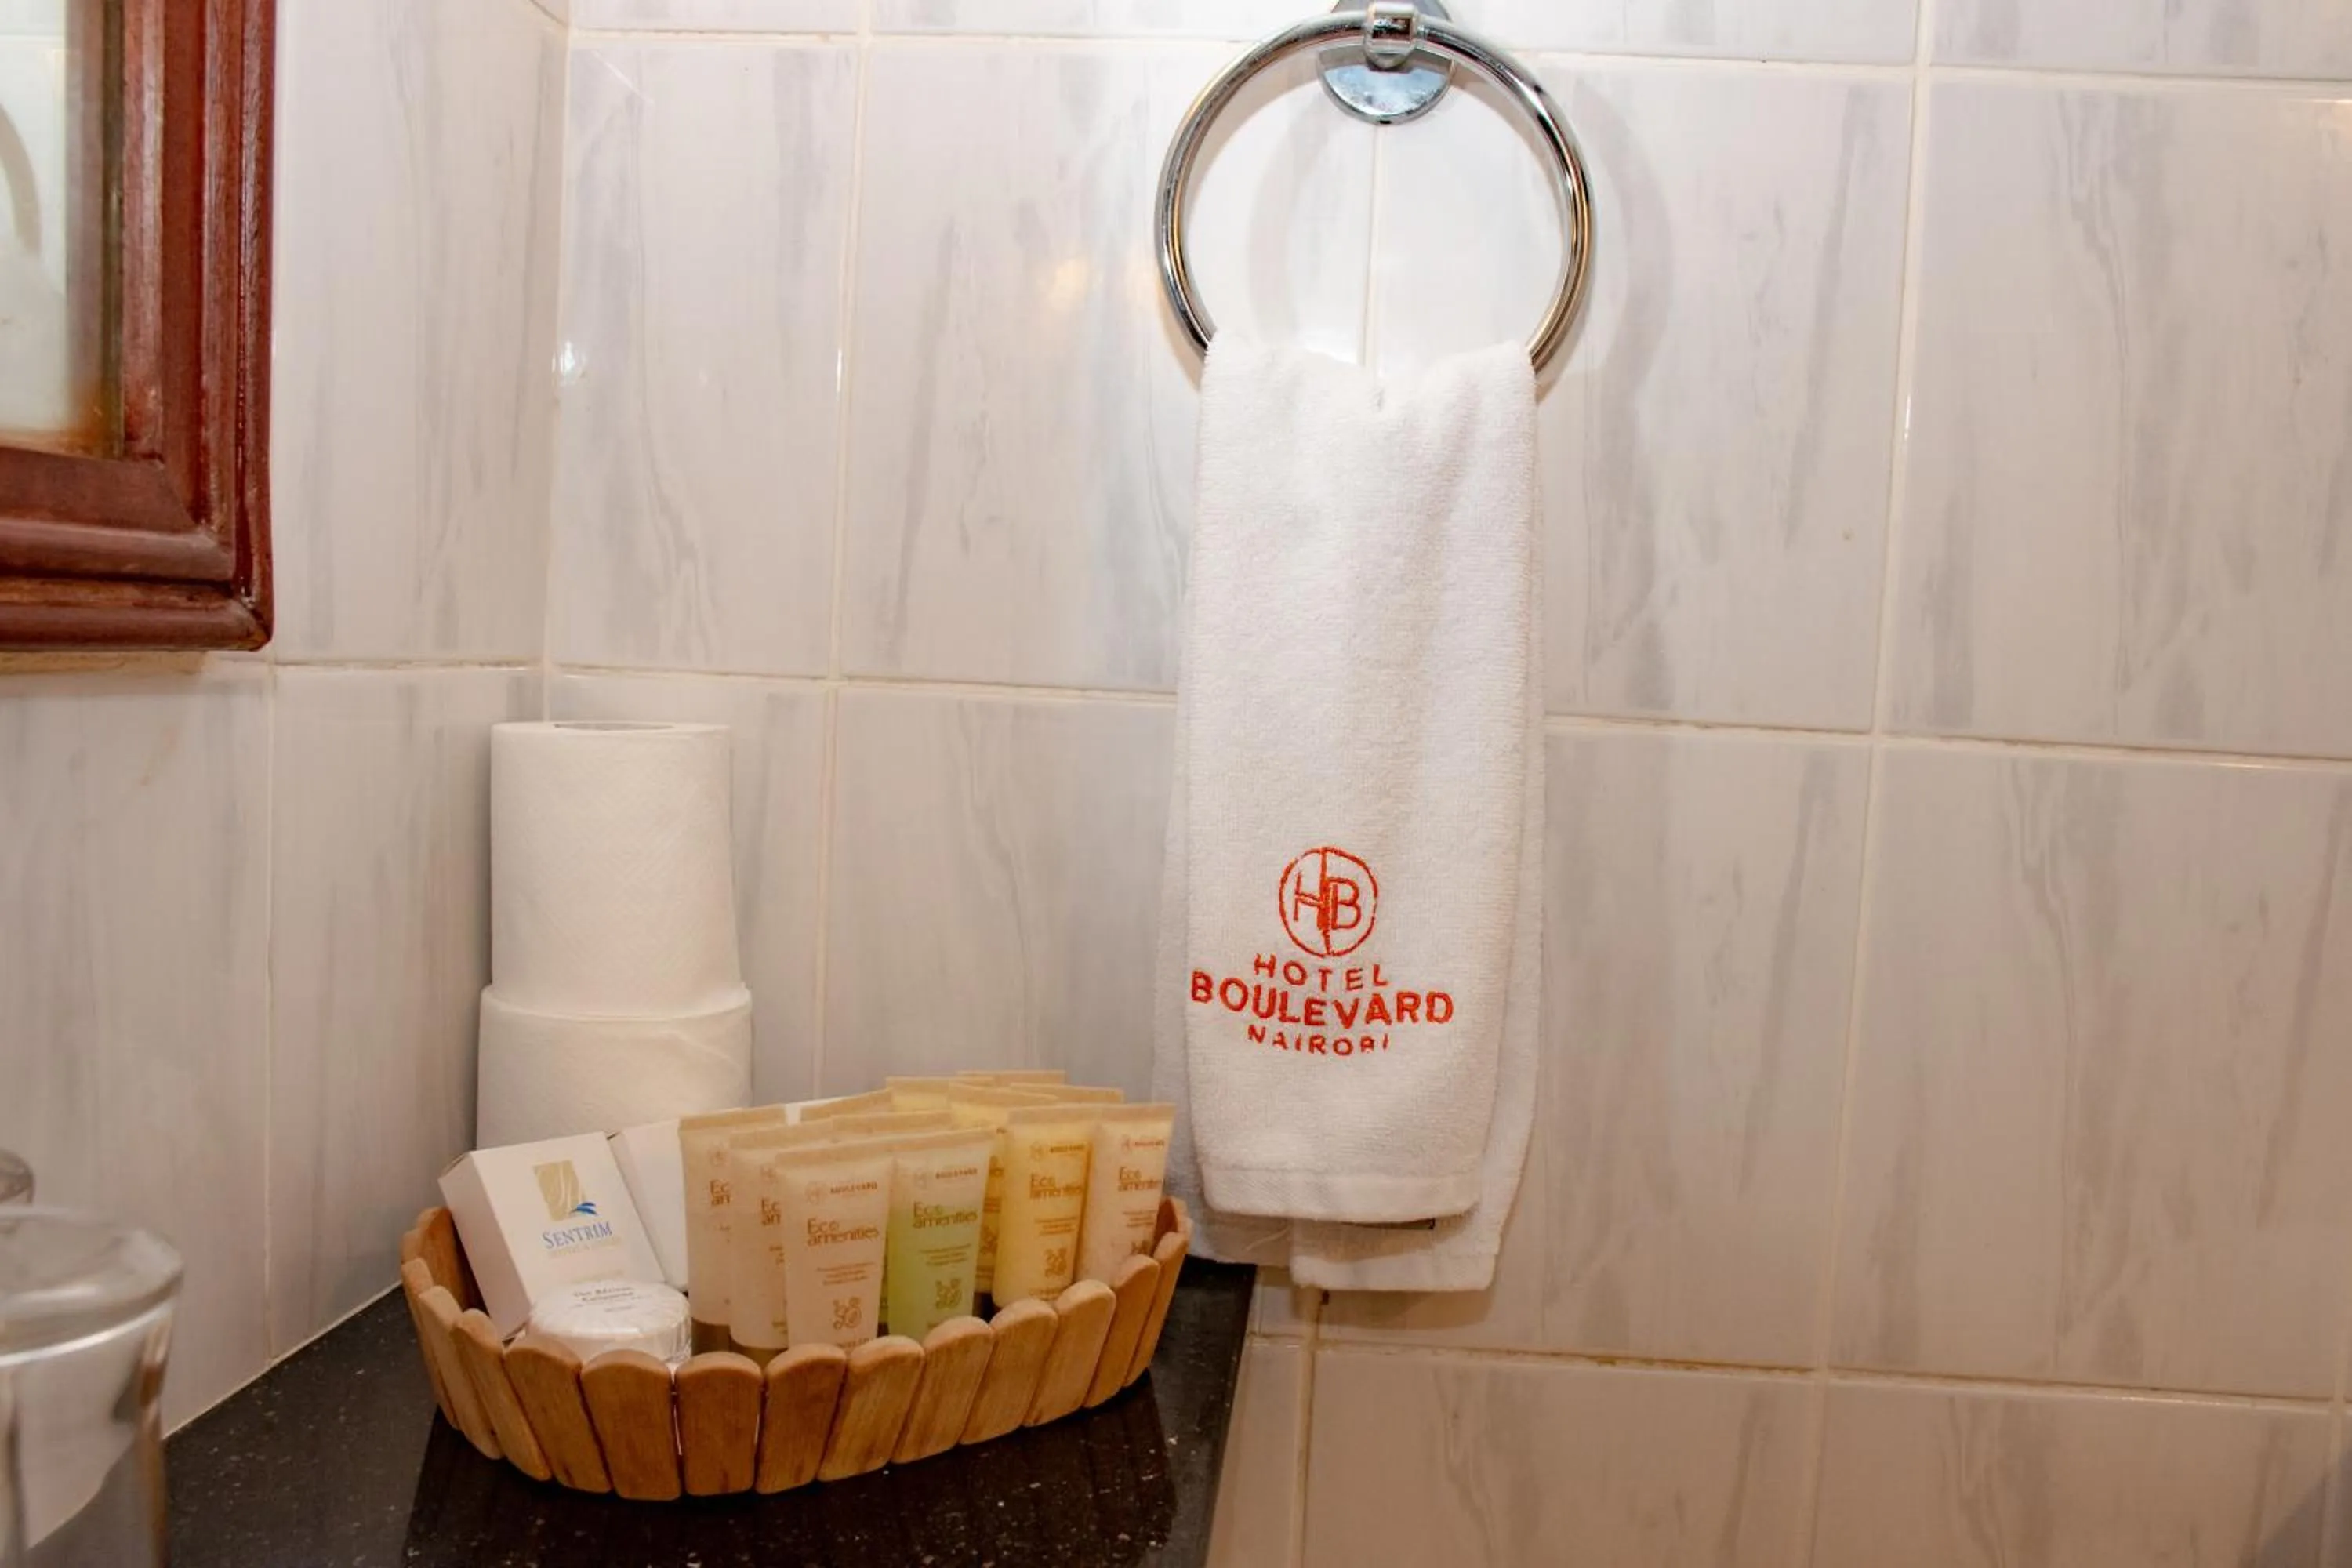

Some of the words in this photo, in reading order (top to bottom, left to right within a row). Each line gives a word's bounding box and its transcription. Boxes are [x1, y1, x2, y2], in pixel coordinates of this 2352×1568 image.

[1254, 953, 1389, 992] HOTEL
[1191, 970, 1454, 1029] BOULEVARD
[1247, 1024, 1388, 1057] NAIROBI
[913, 1201, 944, 1218] Eco
[542, 1221, 613, 1250] SENTRIM
[807, 1225, 880, 1247] amenities
[808, 1218, 839, 1236] Eco
